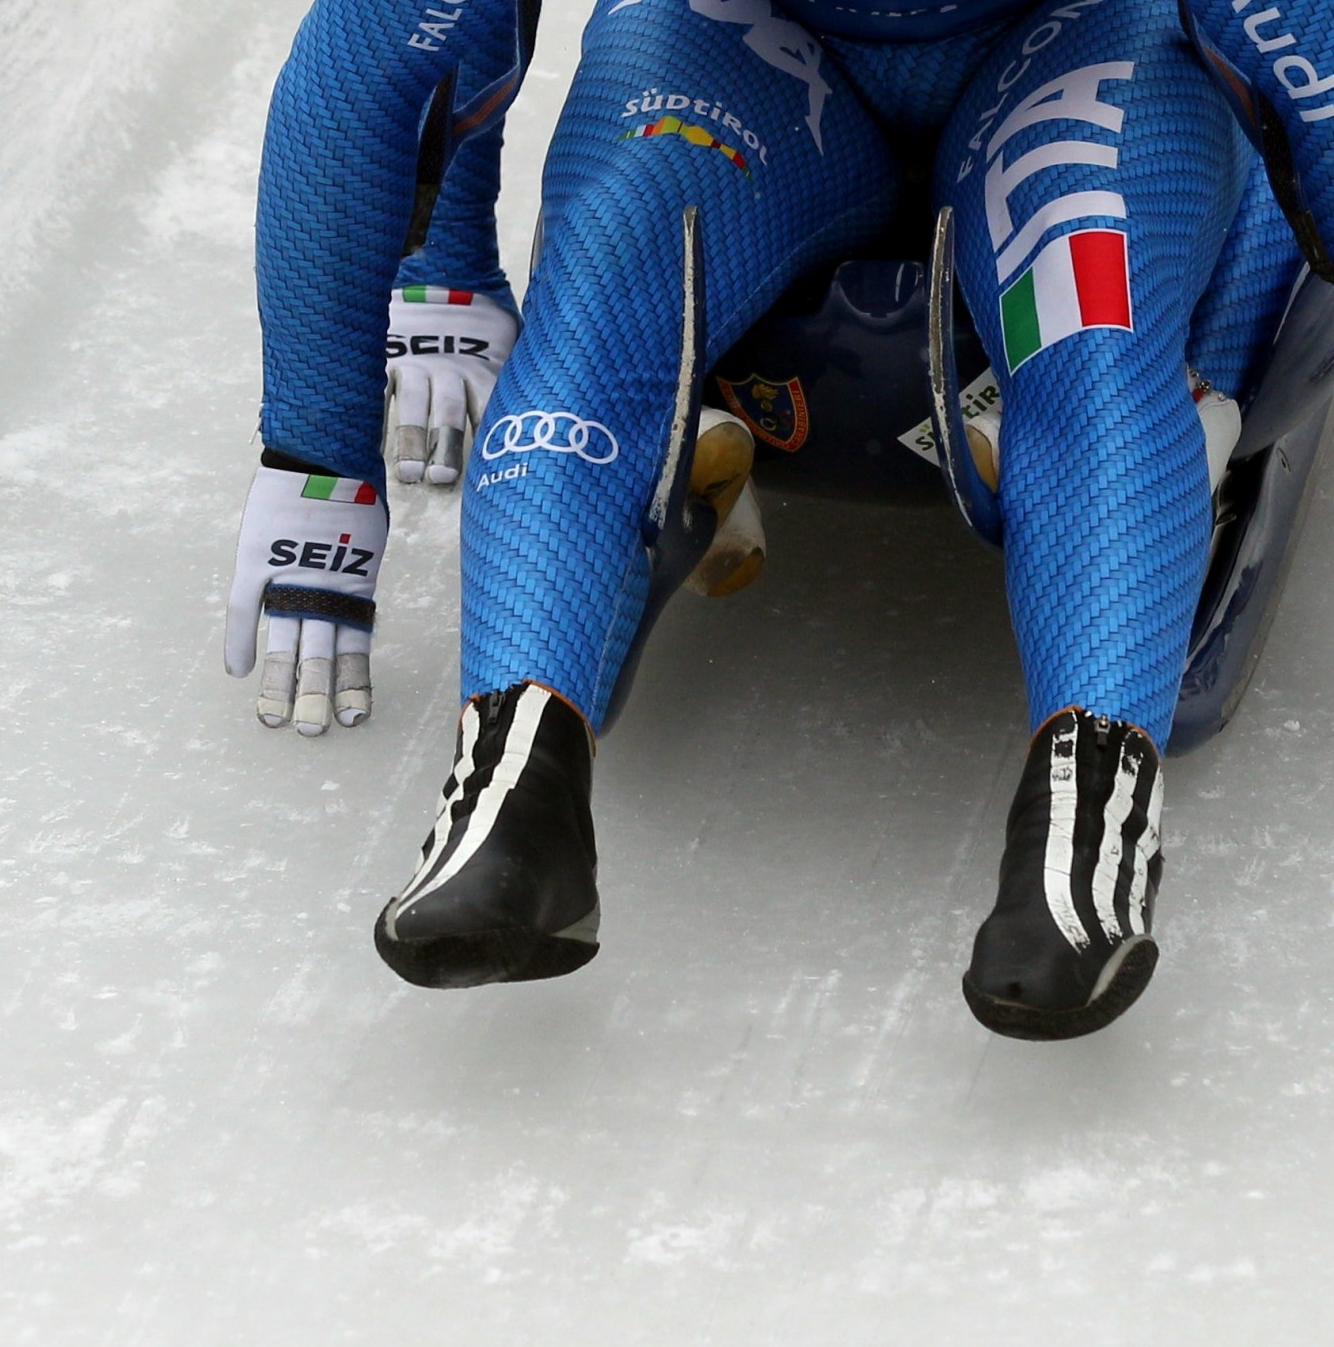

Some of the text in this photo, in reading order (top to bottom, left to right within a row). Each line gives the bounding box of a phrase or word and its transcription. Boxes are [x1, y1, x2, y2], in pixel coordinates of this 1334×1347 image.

[983, 60, 1136, 285] ITA
[475, 462, 529, 491] Audi
[267, 533, 375, 577] SEIZ
